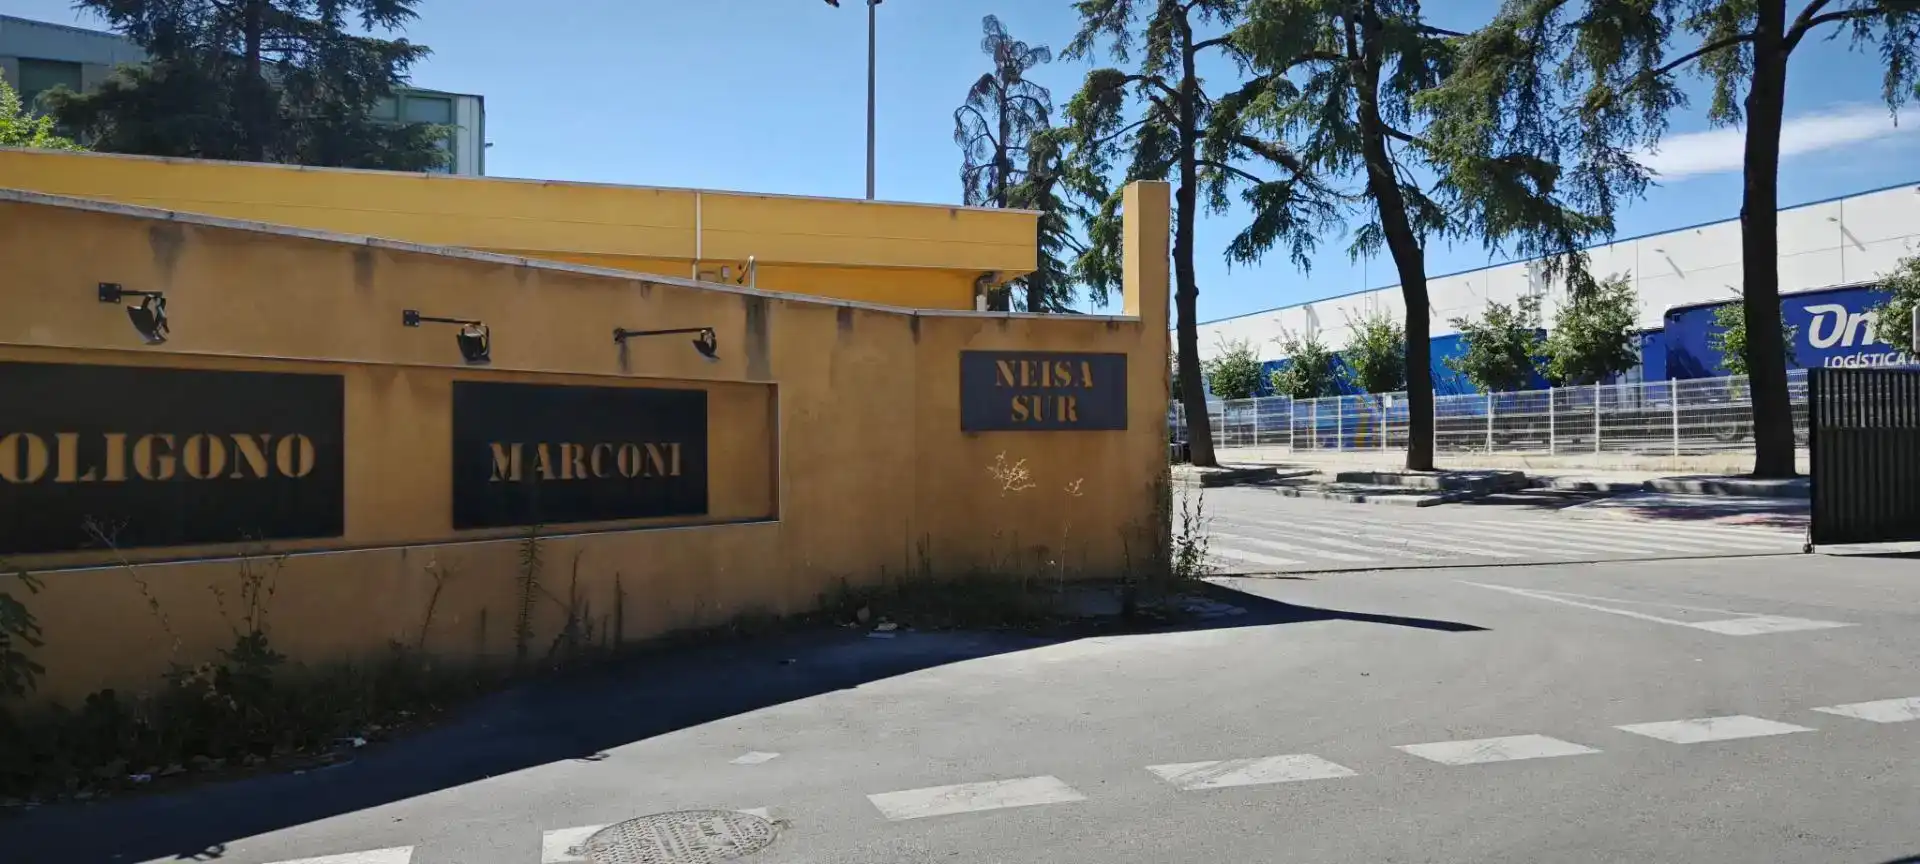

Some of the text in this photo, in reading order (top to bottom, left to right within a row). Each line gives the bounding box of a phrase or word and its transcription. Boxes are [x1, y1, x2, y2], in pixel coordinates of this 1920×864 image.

[1803, 304, 1894, 349] On
[995, 360, 1094, 388] NEISA
[1011, 395, 1079, 422] SUR
[0, 432, 316, 482] OLIGONO
[489, 442, 682, 482] MARCONI
